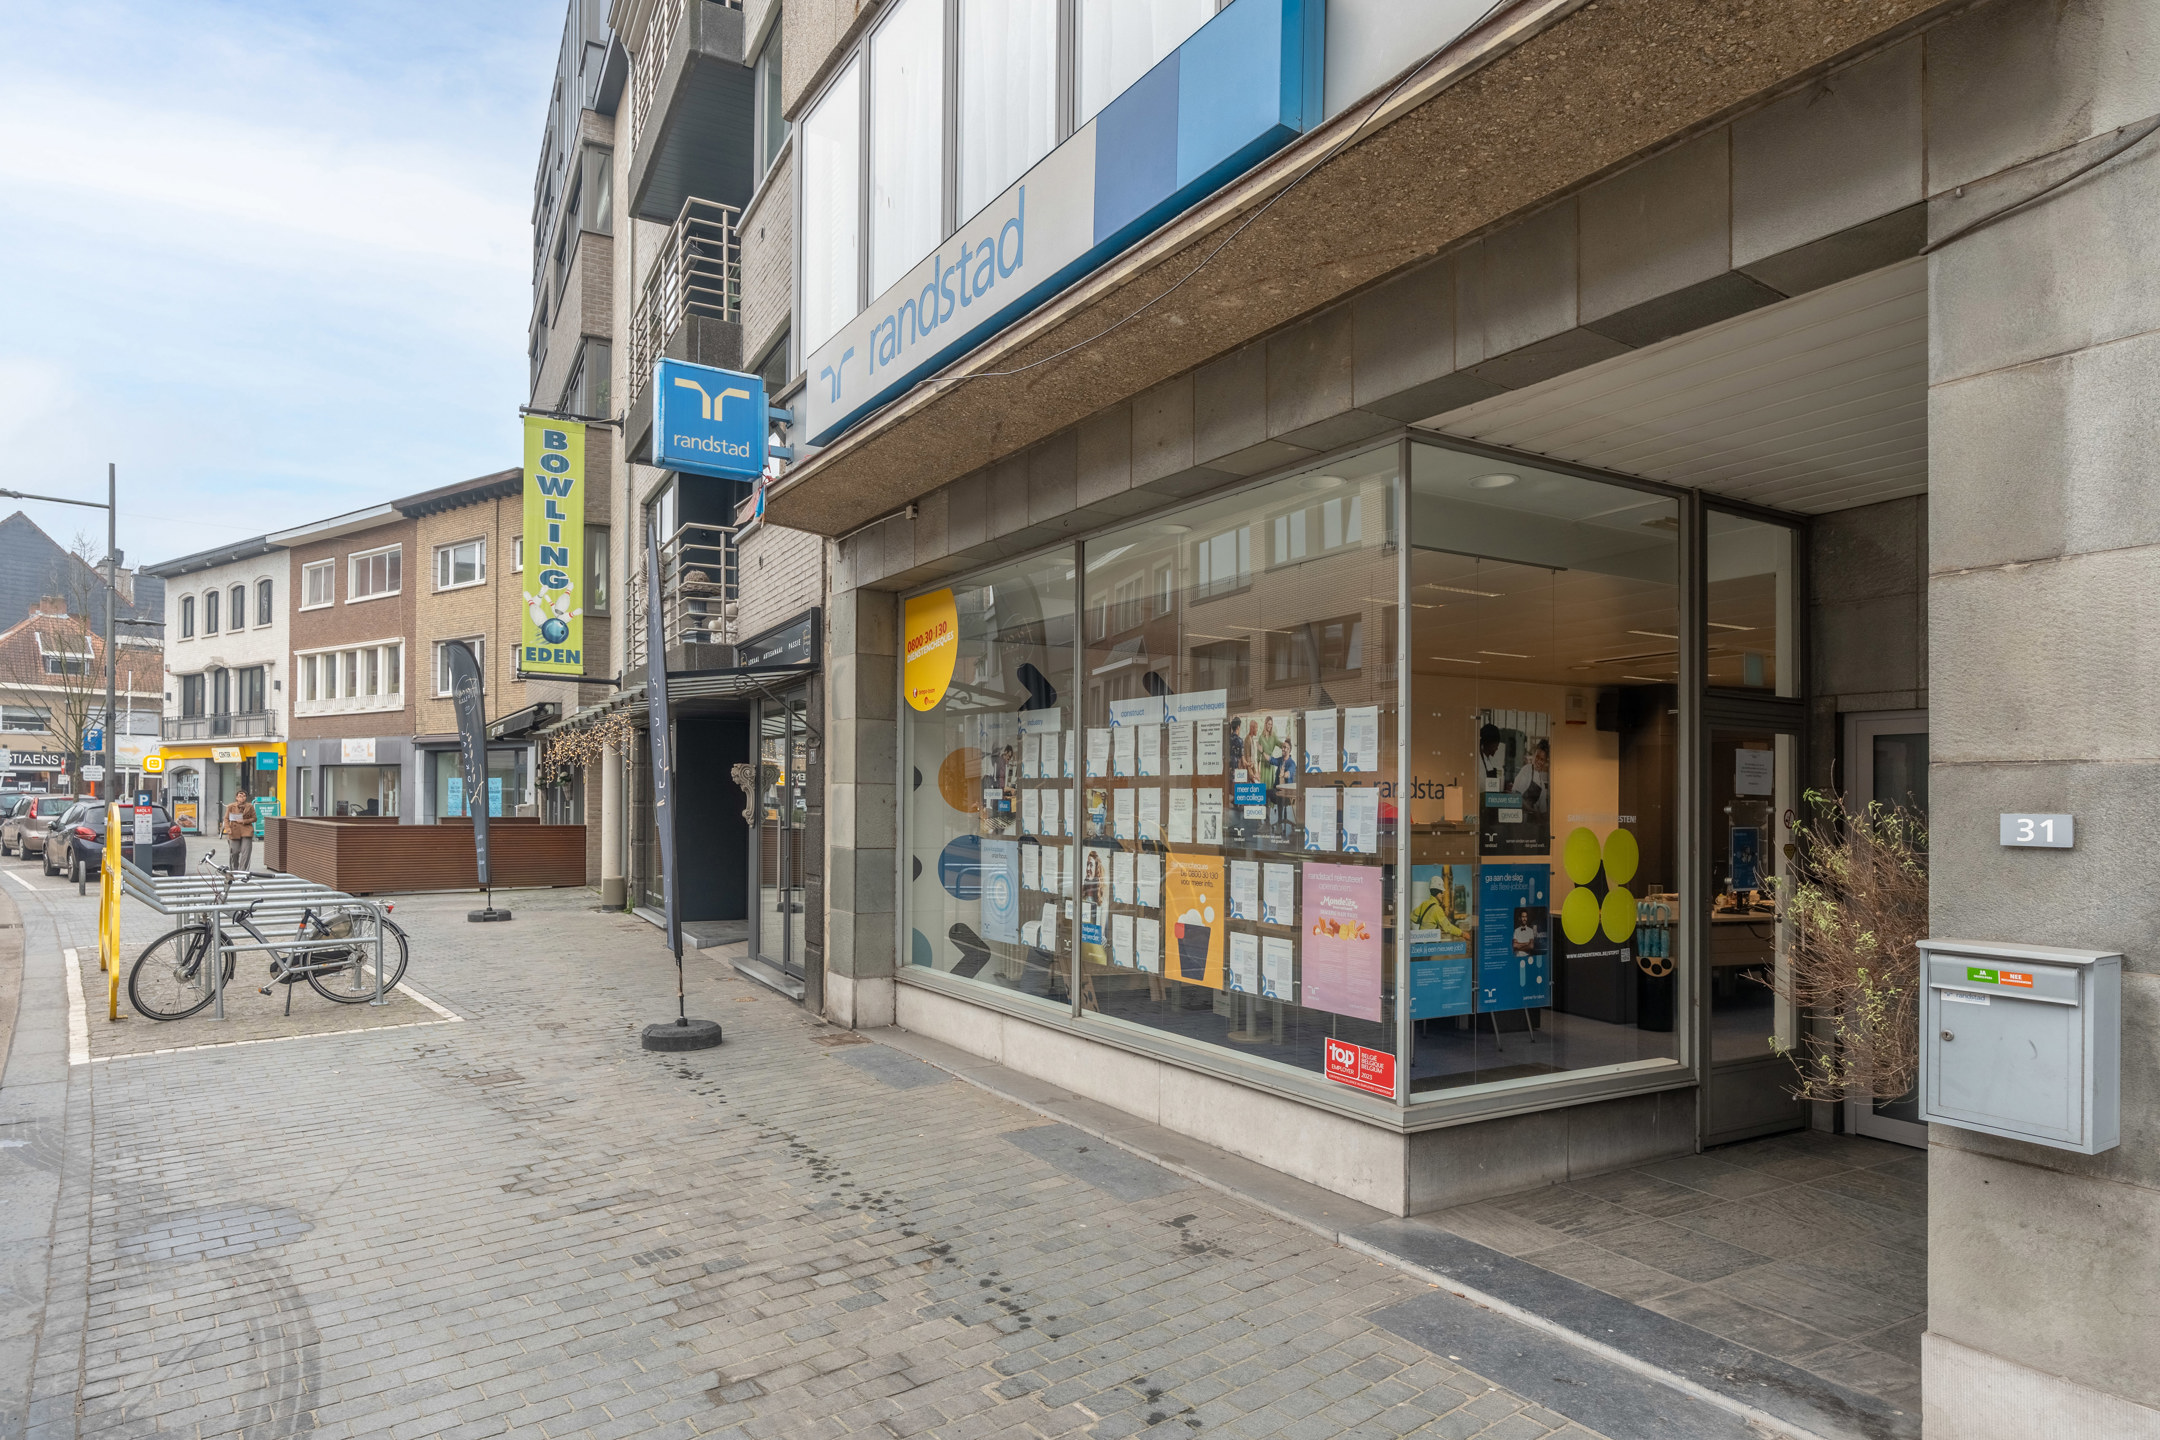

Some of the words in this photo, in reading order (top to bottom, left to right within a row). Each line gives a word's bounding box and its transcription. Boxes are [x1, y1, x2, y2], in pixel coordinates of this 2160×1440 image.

[869, 184, 1025, 376] randstad
[674, 434, 750, 458] randstad
[535, 429, 574, 590] BOWLING
[907, 634, 923, 653] 0800
[924, 628, 933, 644] 30
[935, 621, 947, 638] 130
[907, 630, 954, 663] DIENSTENCHEQUES
[526, 646, 581, 665] EDEN
[1121, 708, 1145, 718] construct
[1178, 701, 1225, 713] dienstencheques
[1236, 785, 1249, 793] meer
[140, 795, 148, 806] P
[2016, 818, 2054, 842] 31
[1329, 1043, 1355, 1068] top
[1361, 1058, 1384, 1069] BELGIQUE
[1331, 1063, 1354, 1076] EMPLOYER
[1361, 1063, 1383, 1074] BELGIUM
[1361, 1072, 1373, 1080] 2023
